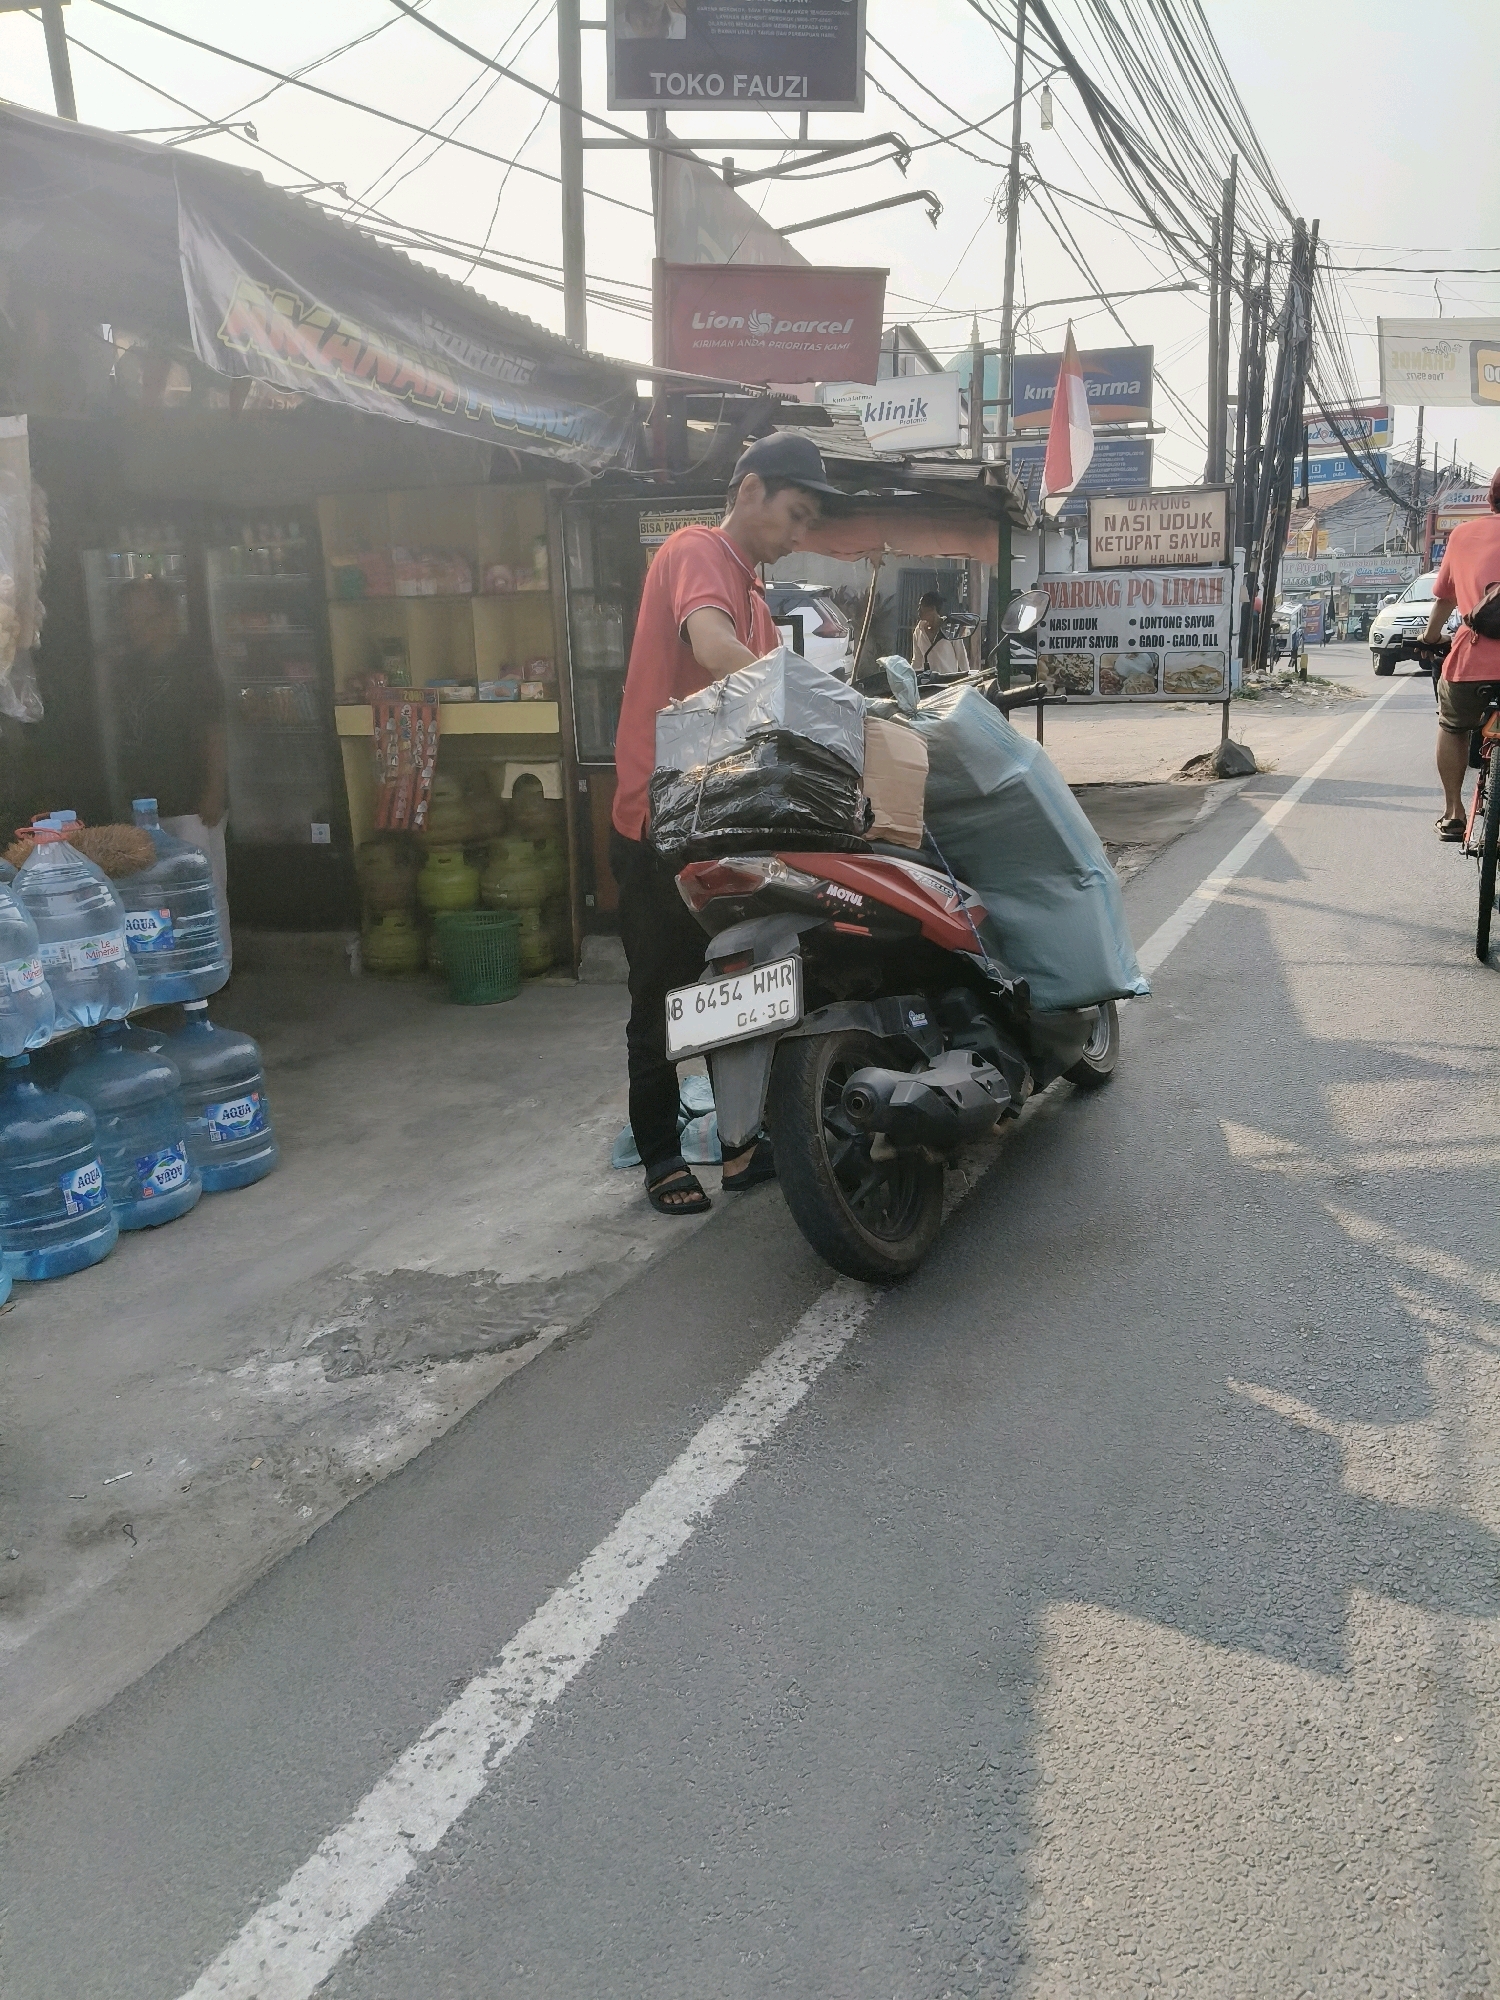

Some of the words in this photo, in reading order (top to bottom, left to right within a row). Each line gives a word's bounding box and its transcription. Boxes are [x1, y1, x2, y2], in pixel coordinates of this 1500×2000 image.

[650, 72, 724, 96] TOKO
[733, 74, 808, 98] FAUZI
[692, 311, 745, 330] Lion
[773, 318, 855, 335] parcel
[218, 272, 460, 412] AMANAH
[692, 338, 735, 349] KIRIMAN
[736, 338, 766, 348] ANDA
[768, 339, 822, 352] PRIORITAS
[824, 342, 851, 352] KAMI
[1024, 384, 1056, 400] kim
[1085, 379, 1141, 397] farma
[865, 397, 929, 422] klinik
[1127, 496, 1191, 512] WARUNG
[640, 522, 662, 534] BISA
[1104, 514, 1150, 532] NASI
[1159, 512, 1213, 531] UDUK
[1095, 534, 1162, 552] KETUPAT
[1169, 531, 1221, 549] SAYUR
[1118, 555, 1139, 564] IBU
[1150, 553, 1199, 564] HALIMAH
[1044, 580, 1121, 608] WARUNG
[1126, 579, 1156, 606] PO
[1161, 577, 1224, 606] LIMAH
[1049, 618, 1071, 631] NASI
[1072, 618, 1098, 630] UDUK
[1139, 616, 1182, 629] LONTONG
[1184, 615, 1215, 628] SAYUR
[1050, 637, 1087, 649] KETUPAT
[1089, 636, 1119, 648] SAYUR
[1139, 635, 1165, 648] GADO
[1172, 634, 1201, 648] GADO,
[1203, 634, 1219, 647] DLL
[827, 885, 862, 906] MOTUL
[126, 917, 157, 931] AQUA
[86, 944, 120, 960] Minerale
[101, 940, 111, 949] Le
[671, 997, 683, 1020] B
[695, 981, 743, 1014] 6454
[753, 964, 793, 996] WMR
[222, 1103, 252, 1121] AQUA
[77, 1167, 100, 1189] AQUA
[155, 1165, 183, 1186] AQUA
